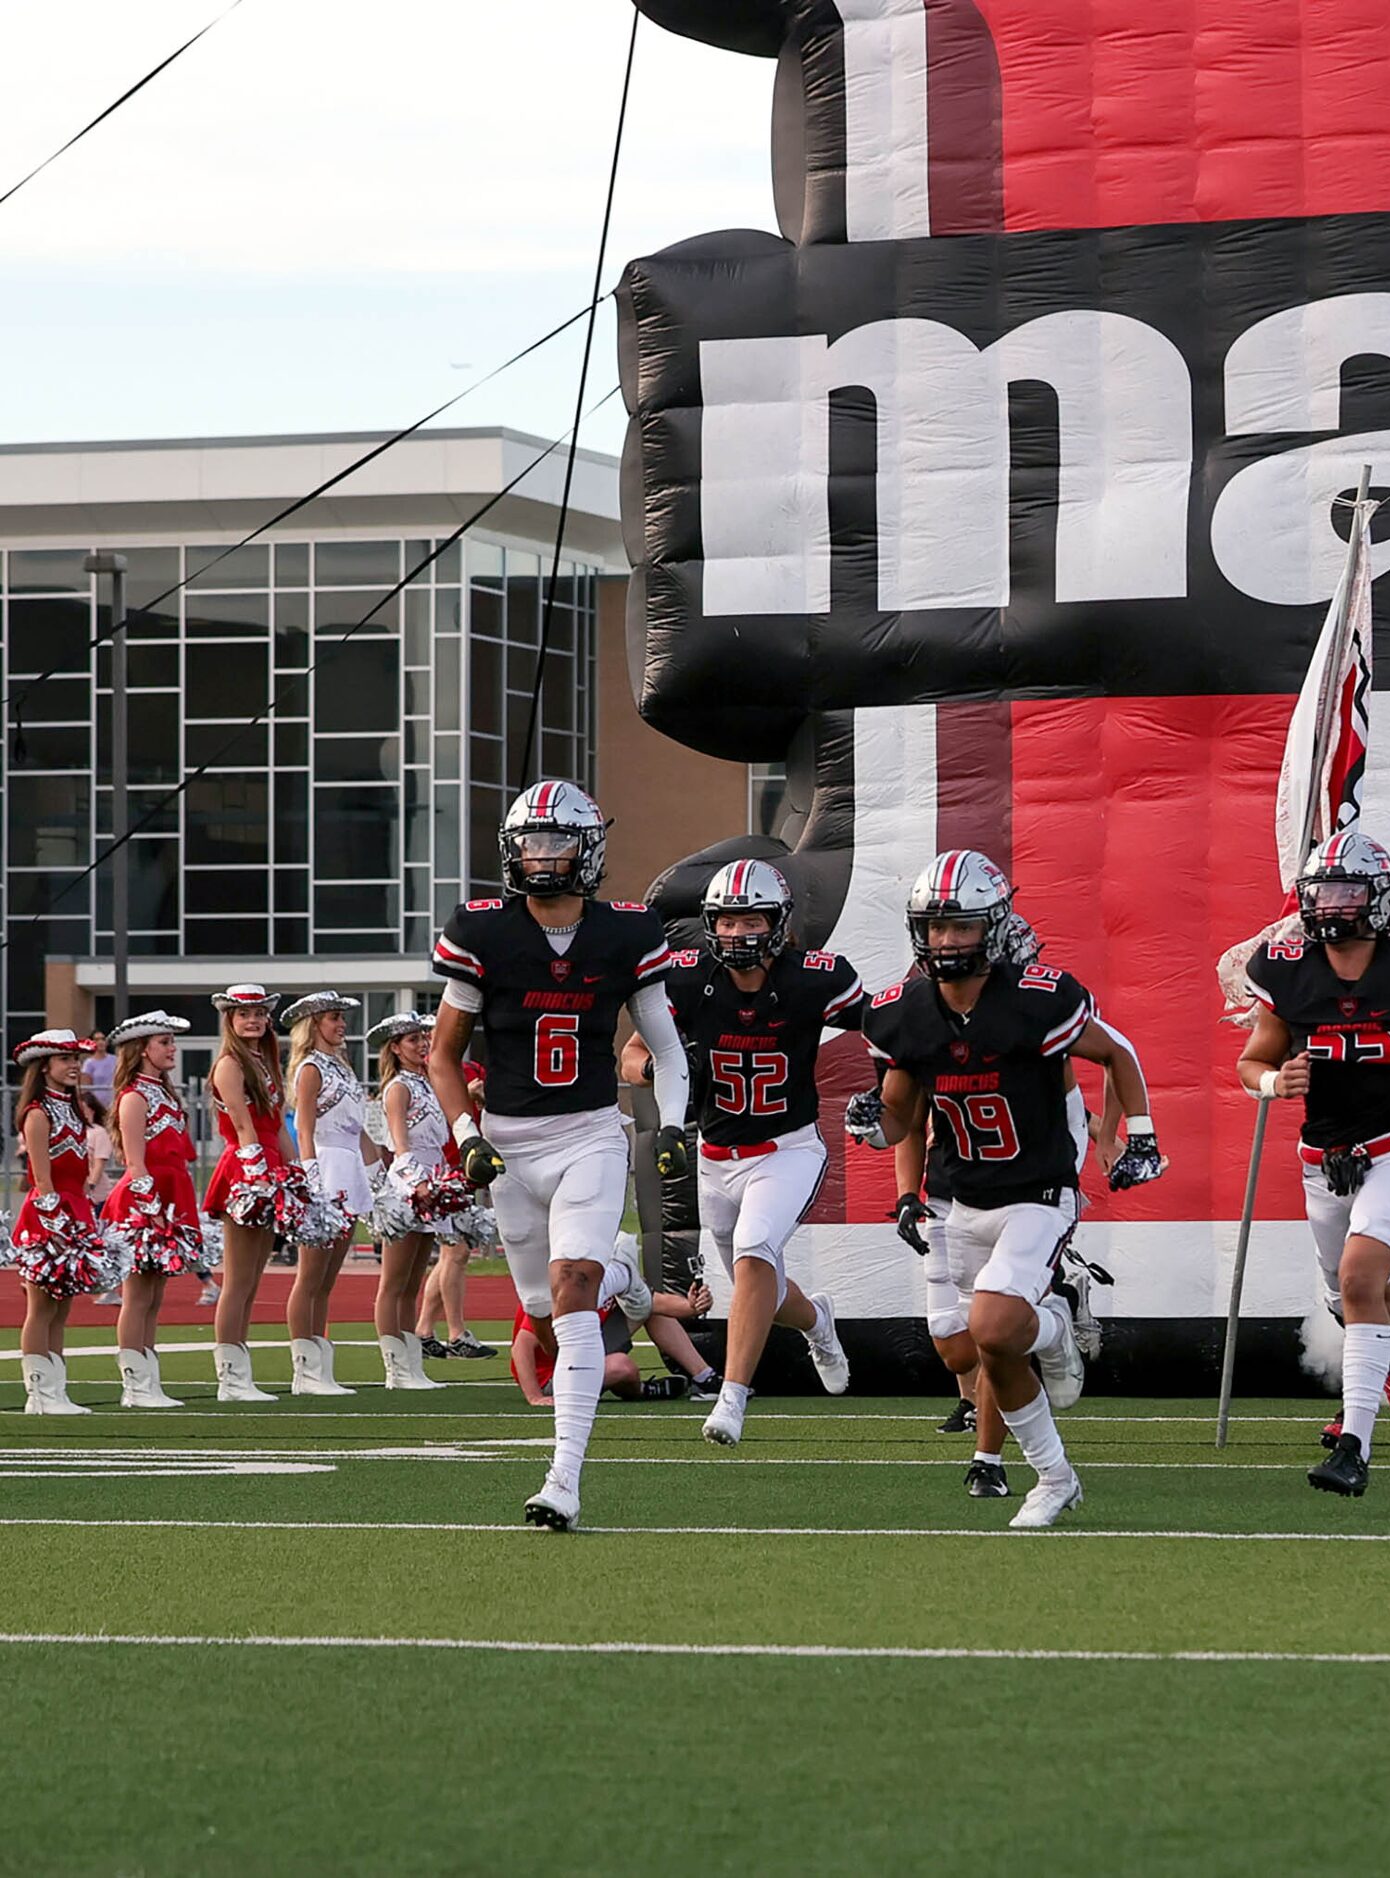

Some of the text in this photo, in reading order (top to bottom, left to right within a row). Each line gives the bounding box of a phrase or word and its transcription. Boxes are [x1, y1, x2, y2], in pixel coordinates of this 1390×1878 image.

[1018, 964, 1063, 993] 19
[522, 991, 595, 1009] MARCUS
[534, 1013, 579, 1087] 6
[719, 1034, 778, 1049] MARCUS
[710, 1049, 788, 1115] 52
[935, 1071, 999, 1091] MARCUS
[934, 1093, 1021, 1162] 19
